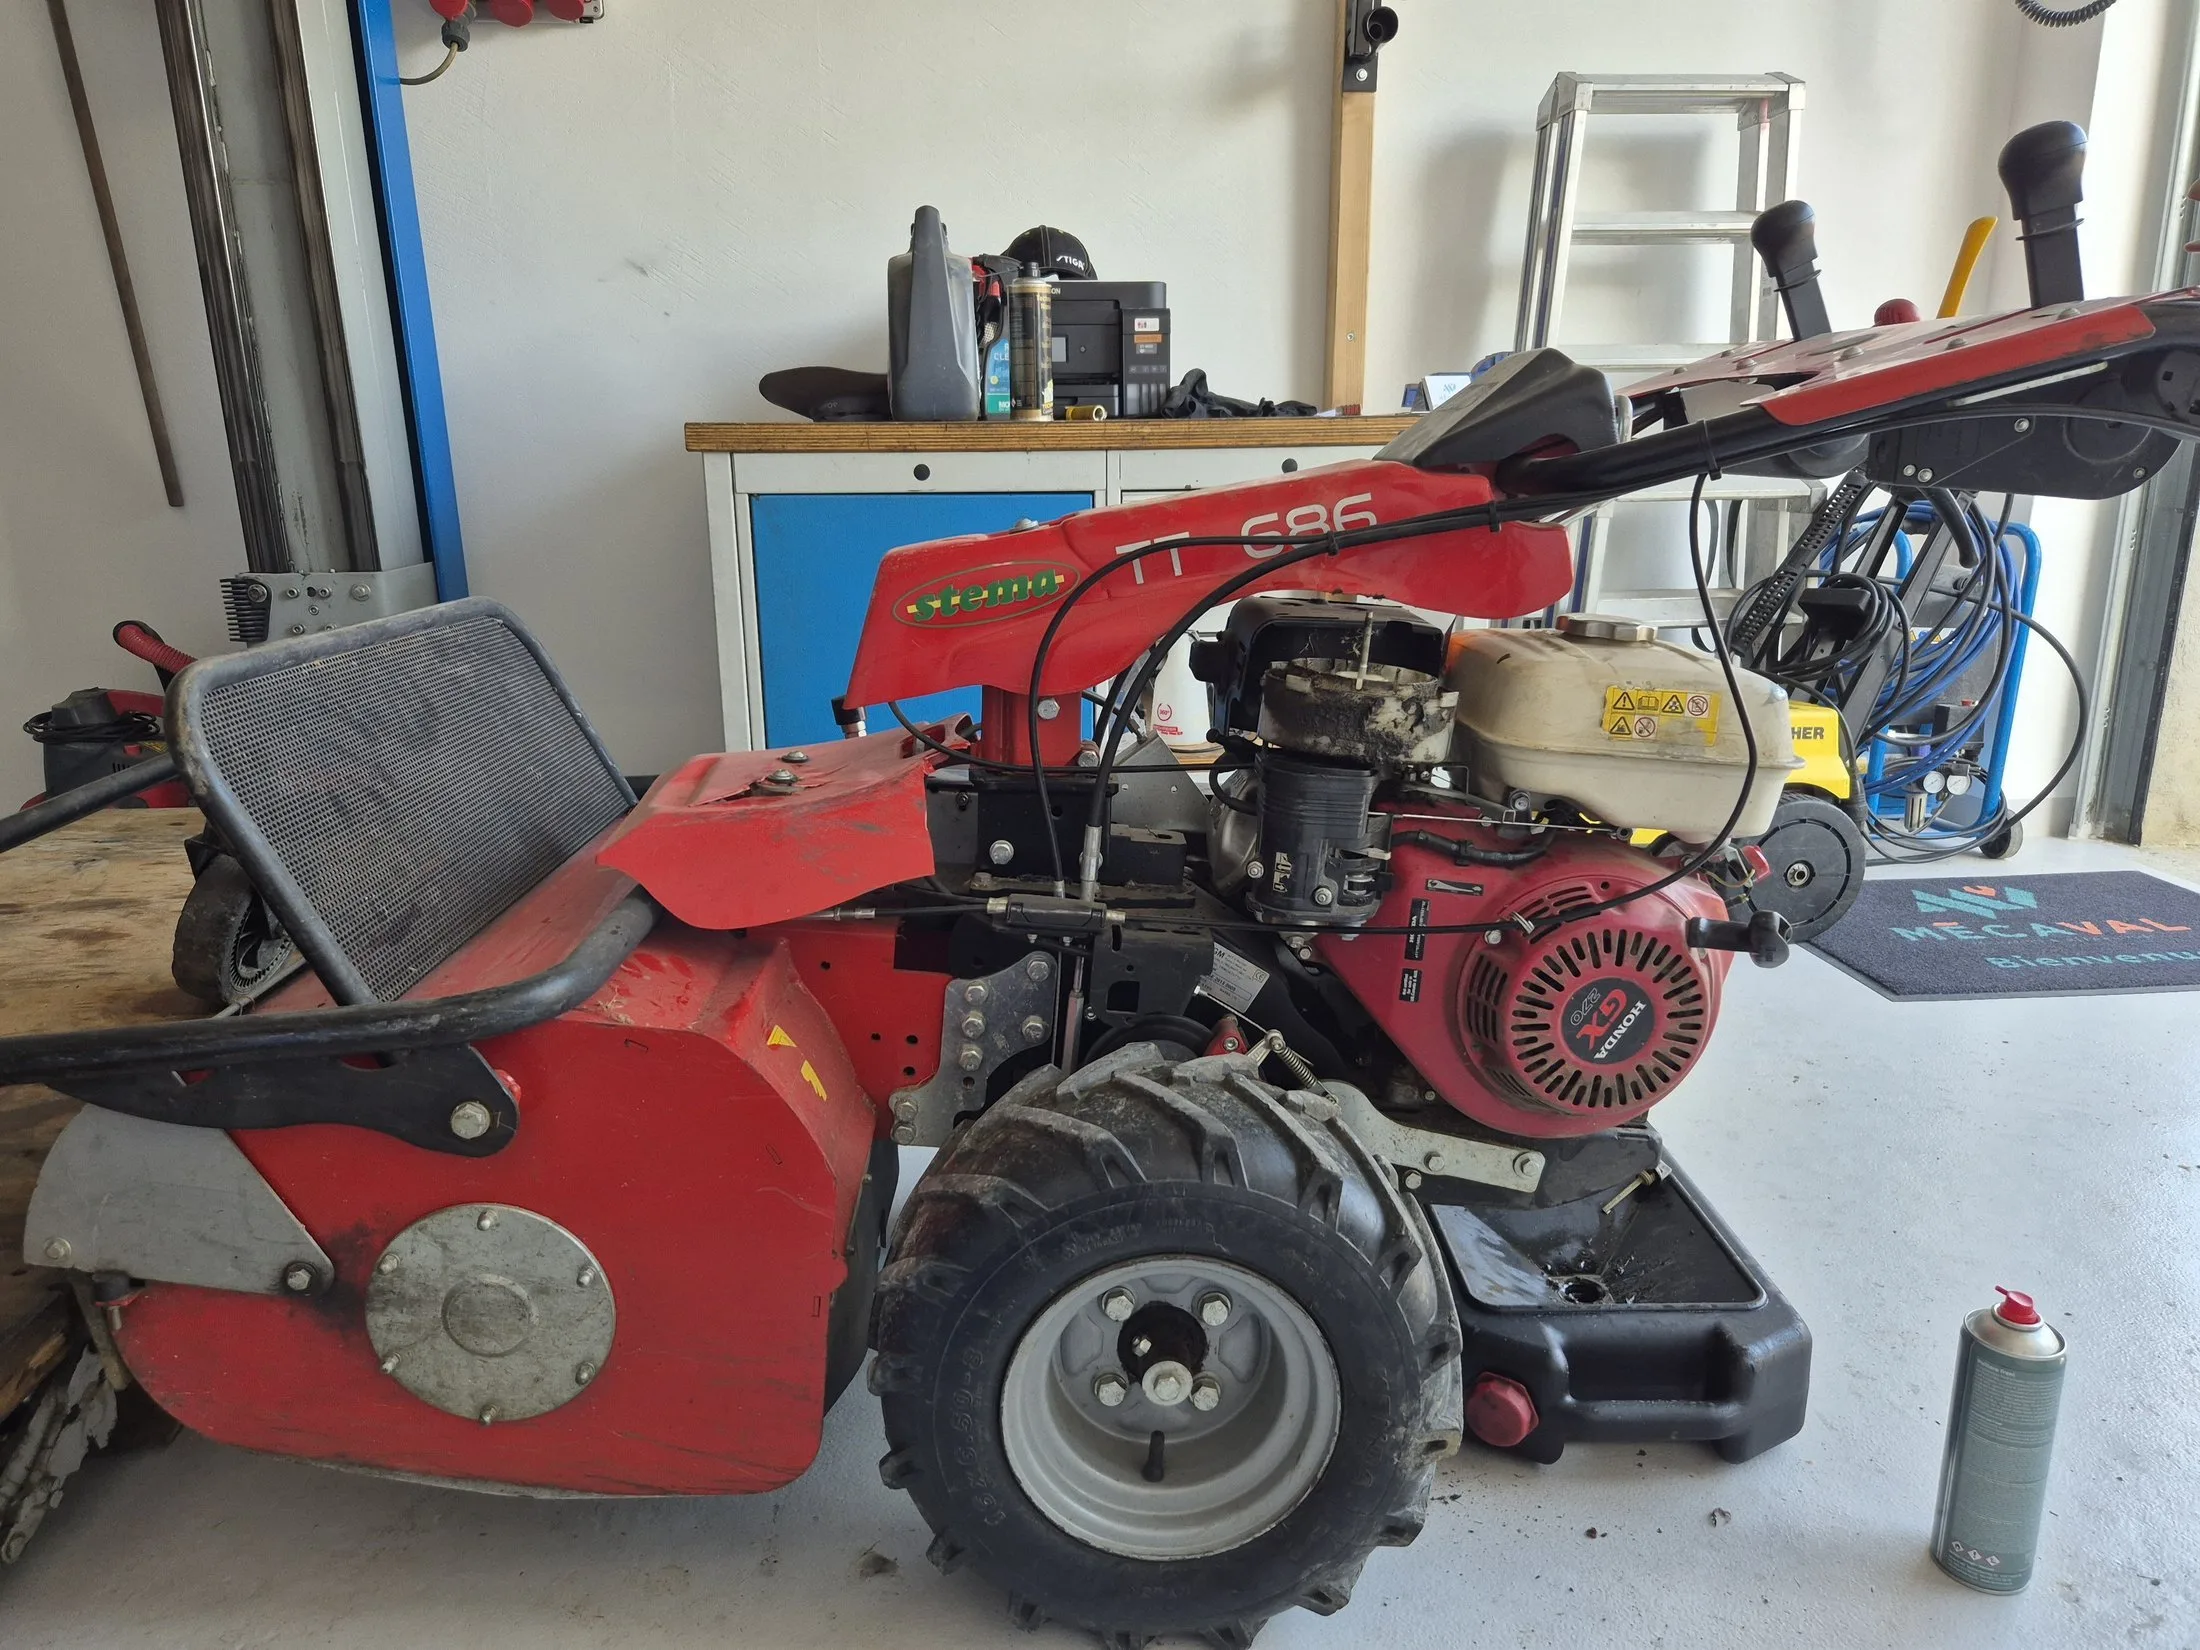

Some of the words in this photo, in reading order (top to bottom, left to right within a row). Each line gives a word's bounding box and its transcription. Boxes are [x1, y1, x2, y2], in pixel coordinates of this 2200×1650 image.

[1056, 255, 1084, 271] STIGA
[1115, 531, 1190, 584] TT
[912, 567, 1060, 622] stema
[1986, 951, 2200, 968] Bienvenu
[1570, 987, 1601, 1026] 270
[1575, 988, 1628, 1051] GX
[1593, 1000, 1647, 1059] HONDA
